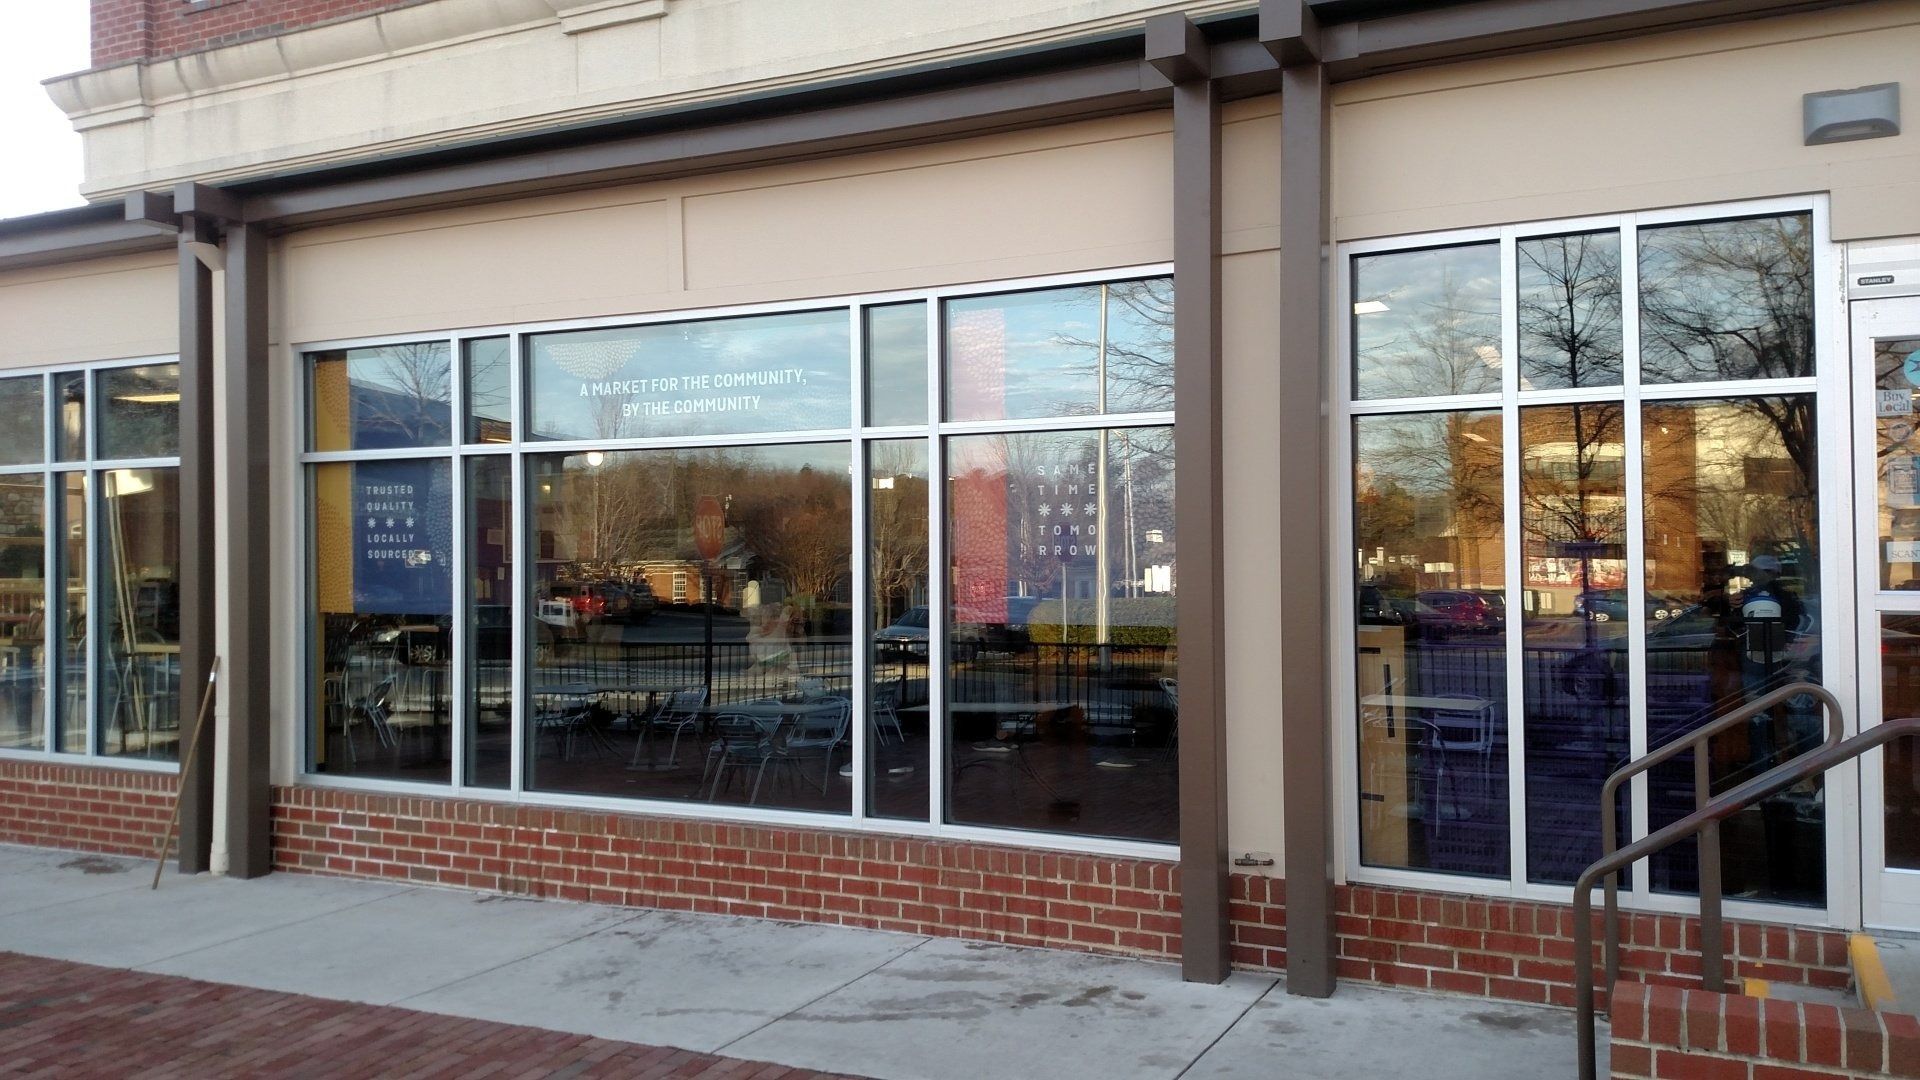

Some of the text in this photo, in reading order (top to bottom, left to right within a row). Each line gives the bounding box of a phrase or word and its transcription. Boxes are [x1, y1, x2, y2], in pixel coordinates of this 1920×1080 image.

[1860, 277, 1892, 285] STANLEY
[579, 368, 807, 397] A MARKET FOR THE COMMUNITY,
[622, 395, 761, 417] BY THE COMMUNITY
[1037, 463, 1096, 476] SAME
[366, 485, 414, 495] TRUSTED
[1037, 483, 1096, 496] TIME
[366, 501, 414, 513] QUALITY
[1038, 524, 1096, 536] TOMO
[367, 533, 415, 543] LOCALLY
[367, 549, 415, 560] SOURCED
[1039, 544, 1097, 556] RROW
